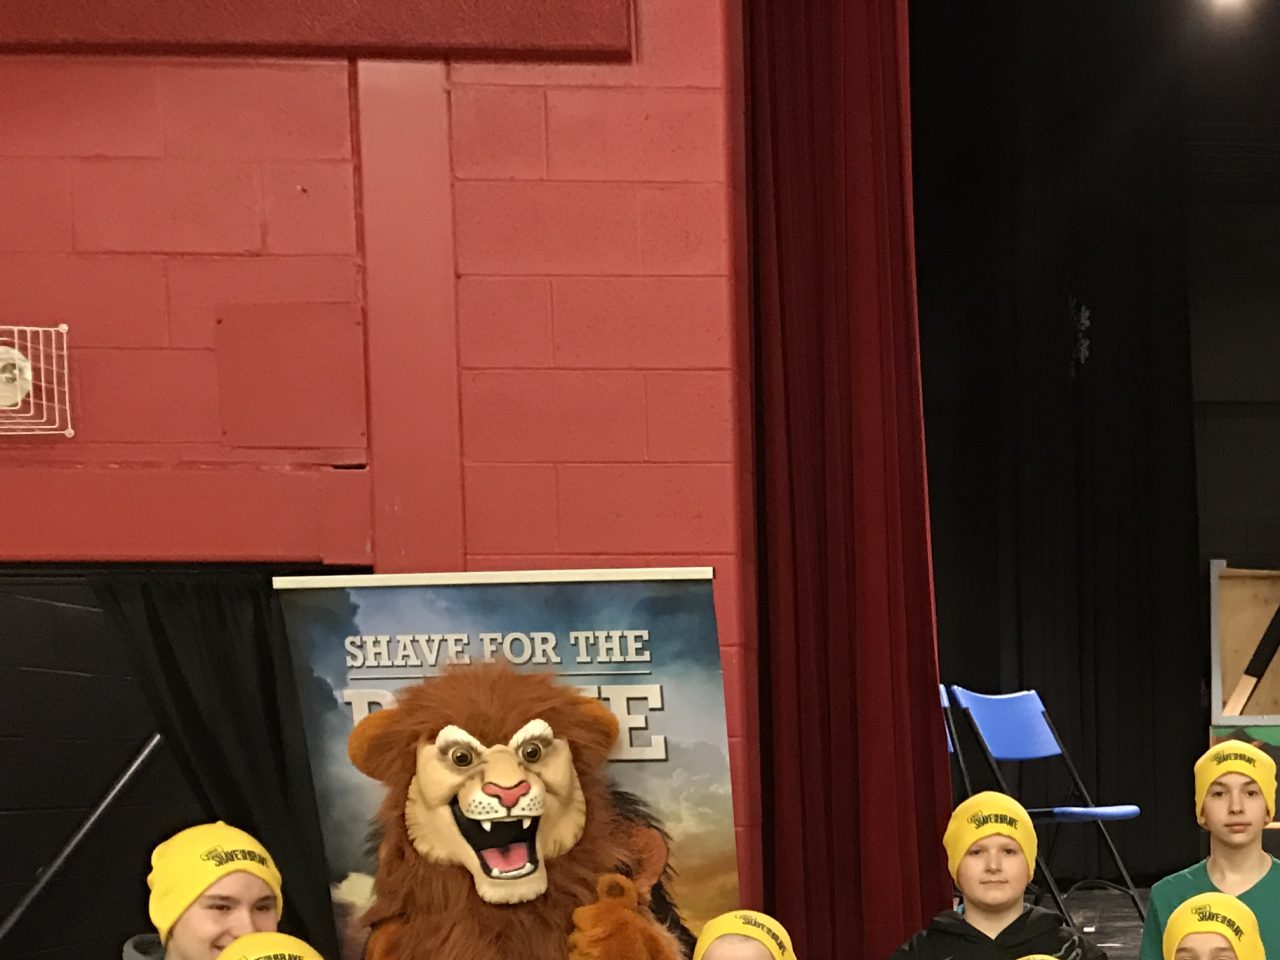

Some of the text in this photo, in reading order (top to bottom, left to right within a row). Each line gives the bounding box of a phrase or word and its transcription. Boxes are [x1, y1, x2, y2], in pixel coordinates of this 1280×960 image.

[344, 629, 651, 668] SHAVE FOR THE
[1198, 911, 1220, 922] SHAVE
